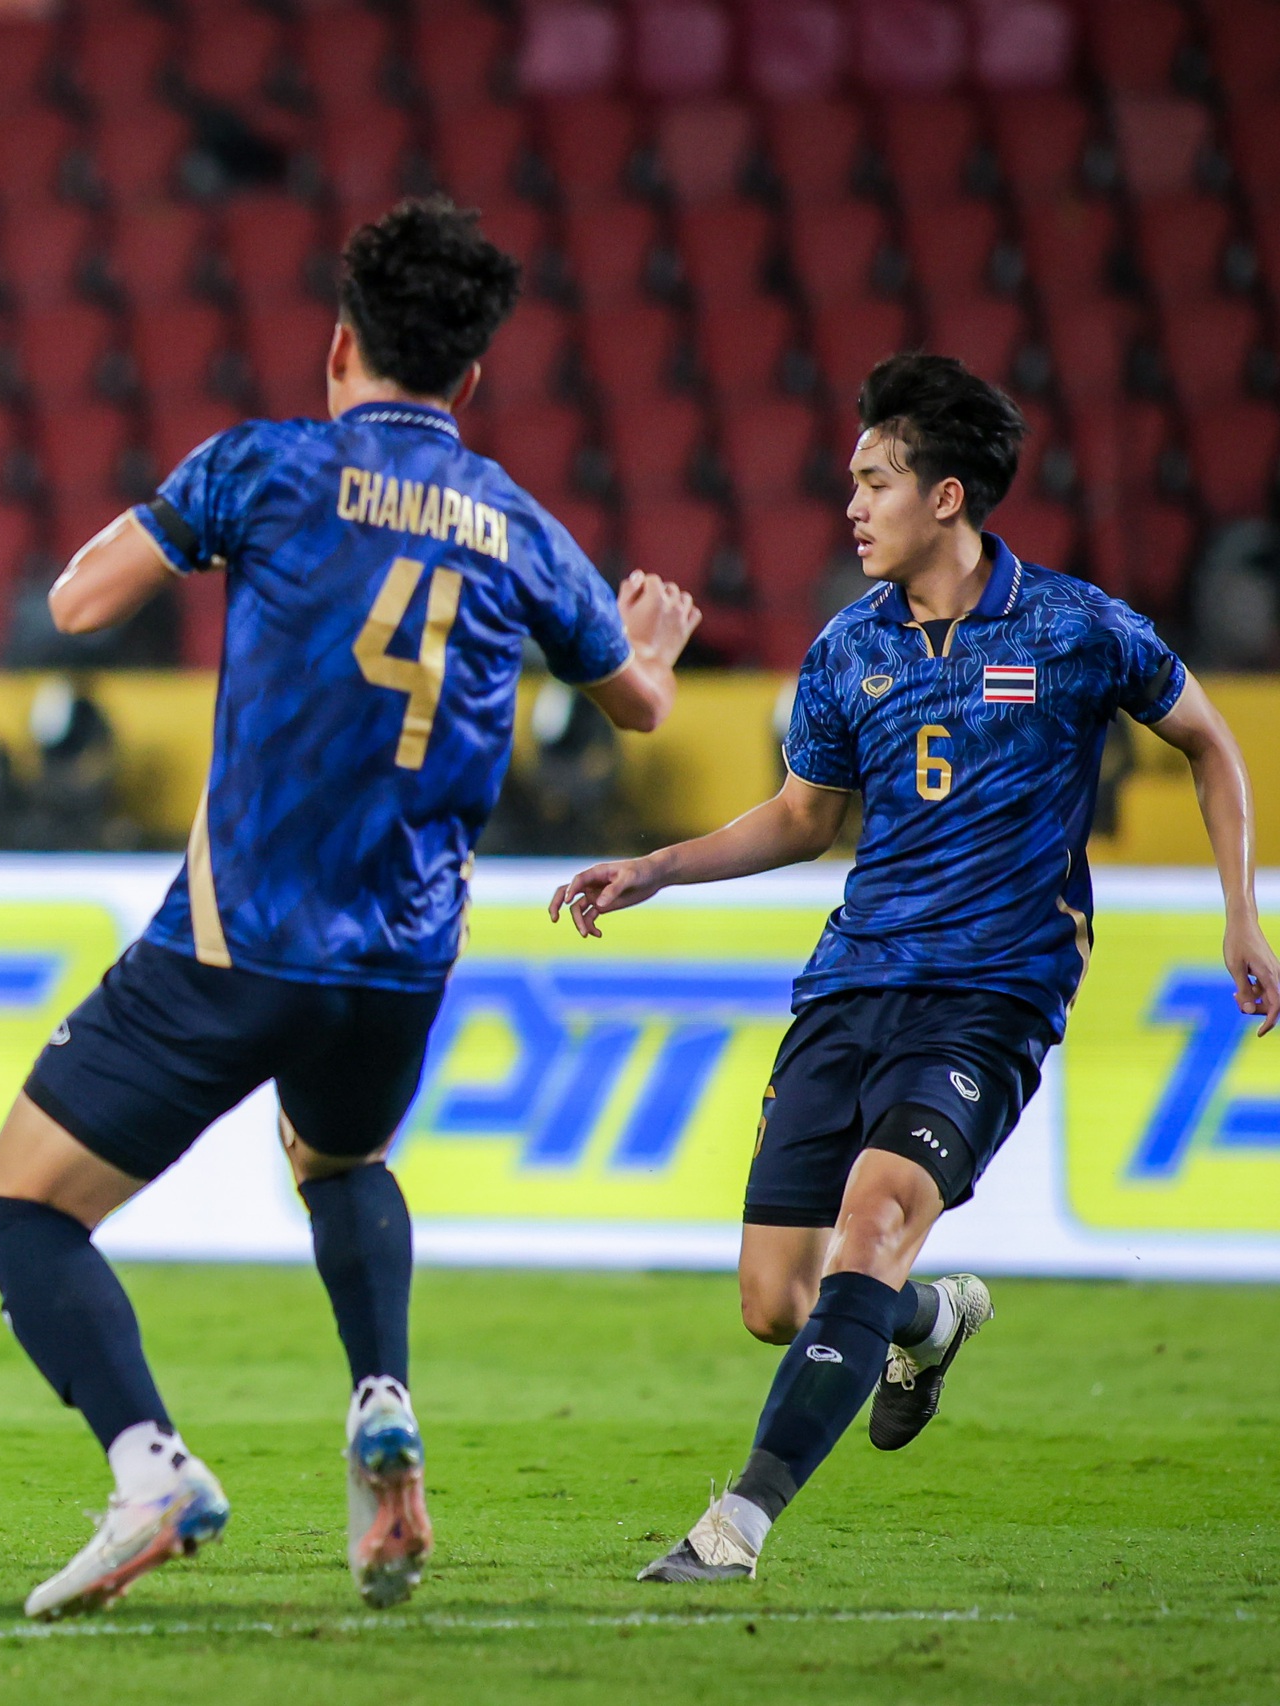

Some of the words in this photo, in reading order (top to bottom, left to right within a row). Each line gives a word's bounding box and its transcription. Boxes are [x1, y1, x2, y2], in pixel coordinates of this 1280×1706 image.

[337, 466, 508, 563] CHANAPACH
[353, 557, 463, 770] 4
[916, 725, 952, 801] 6
